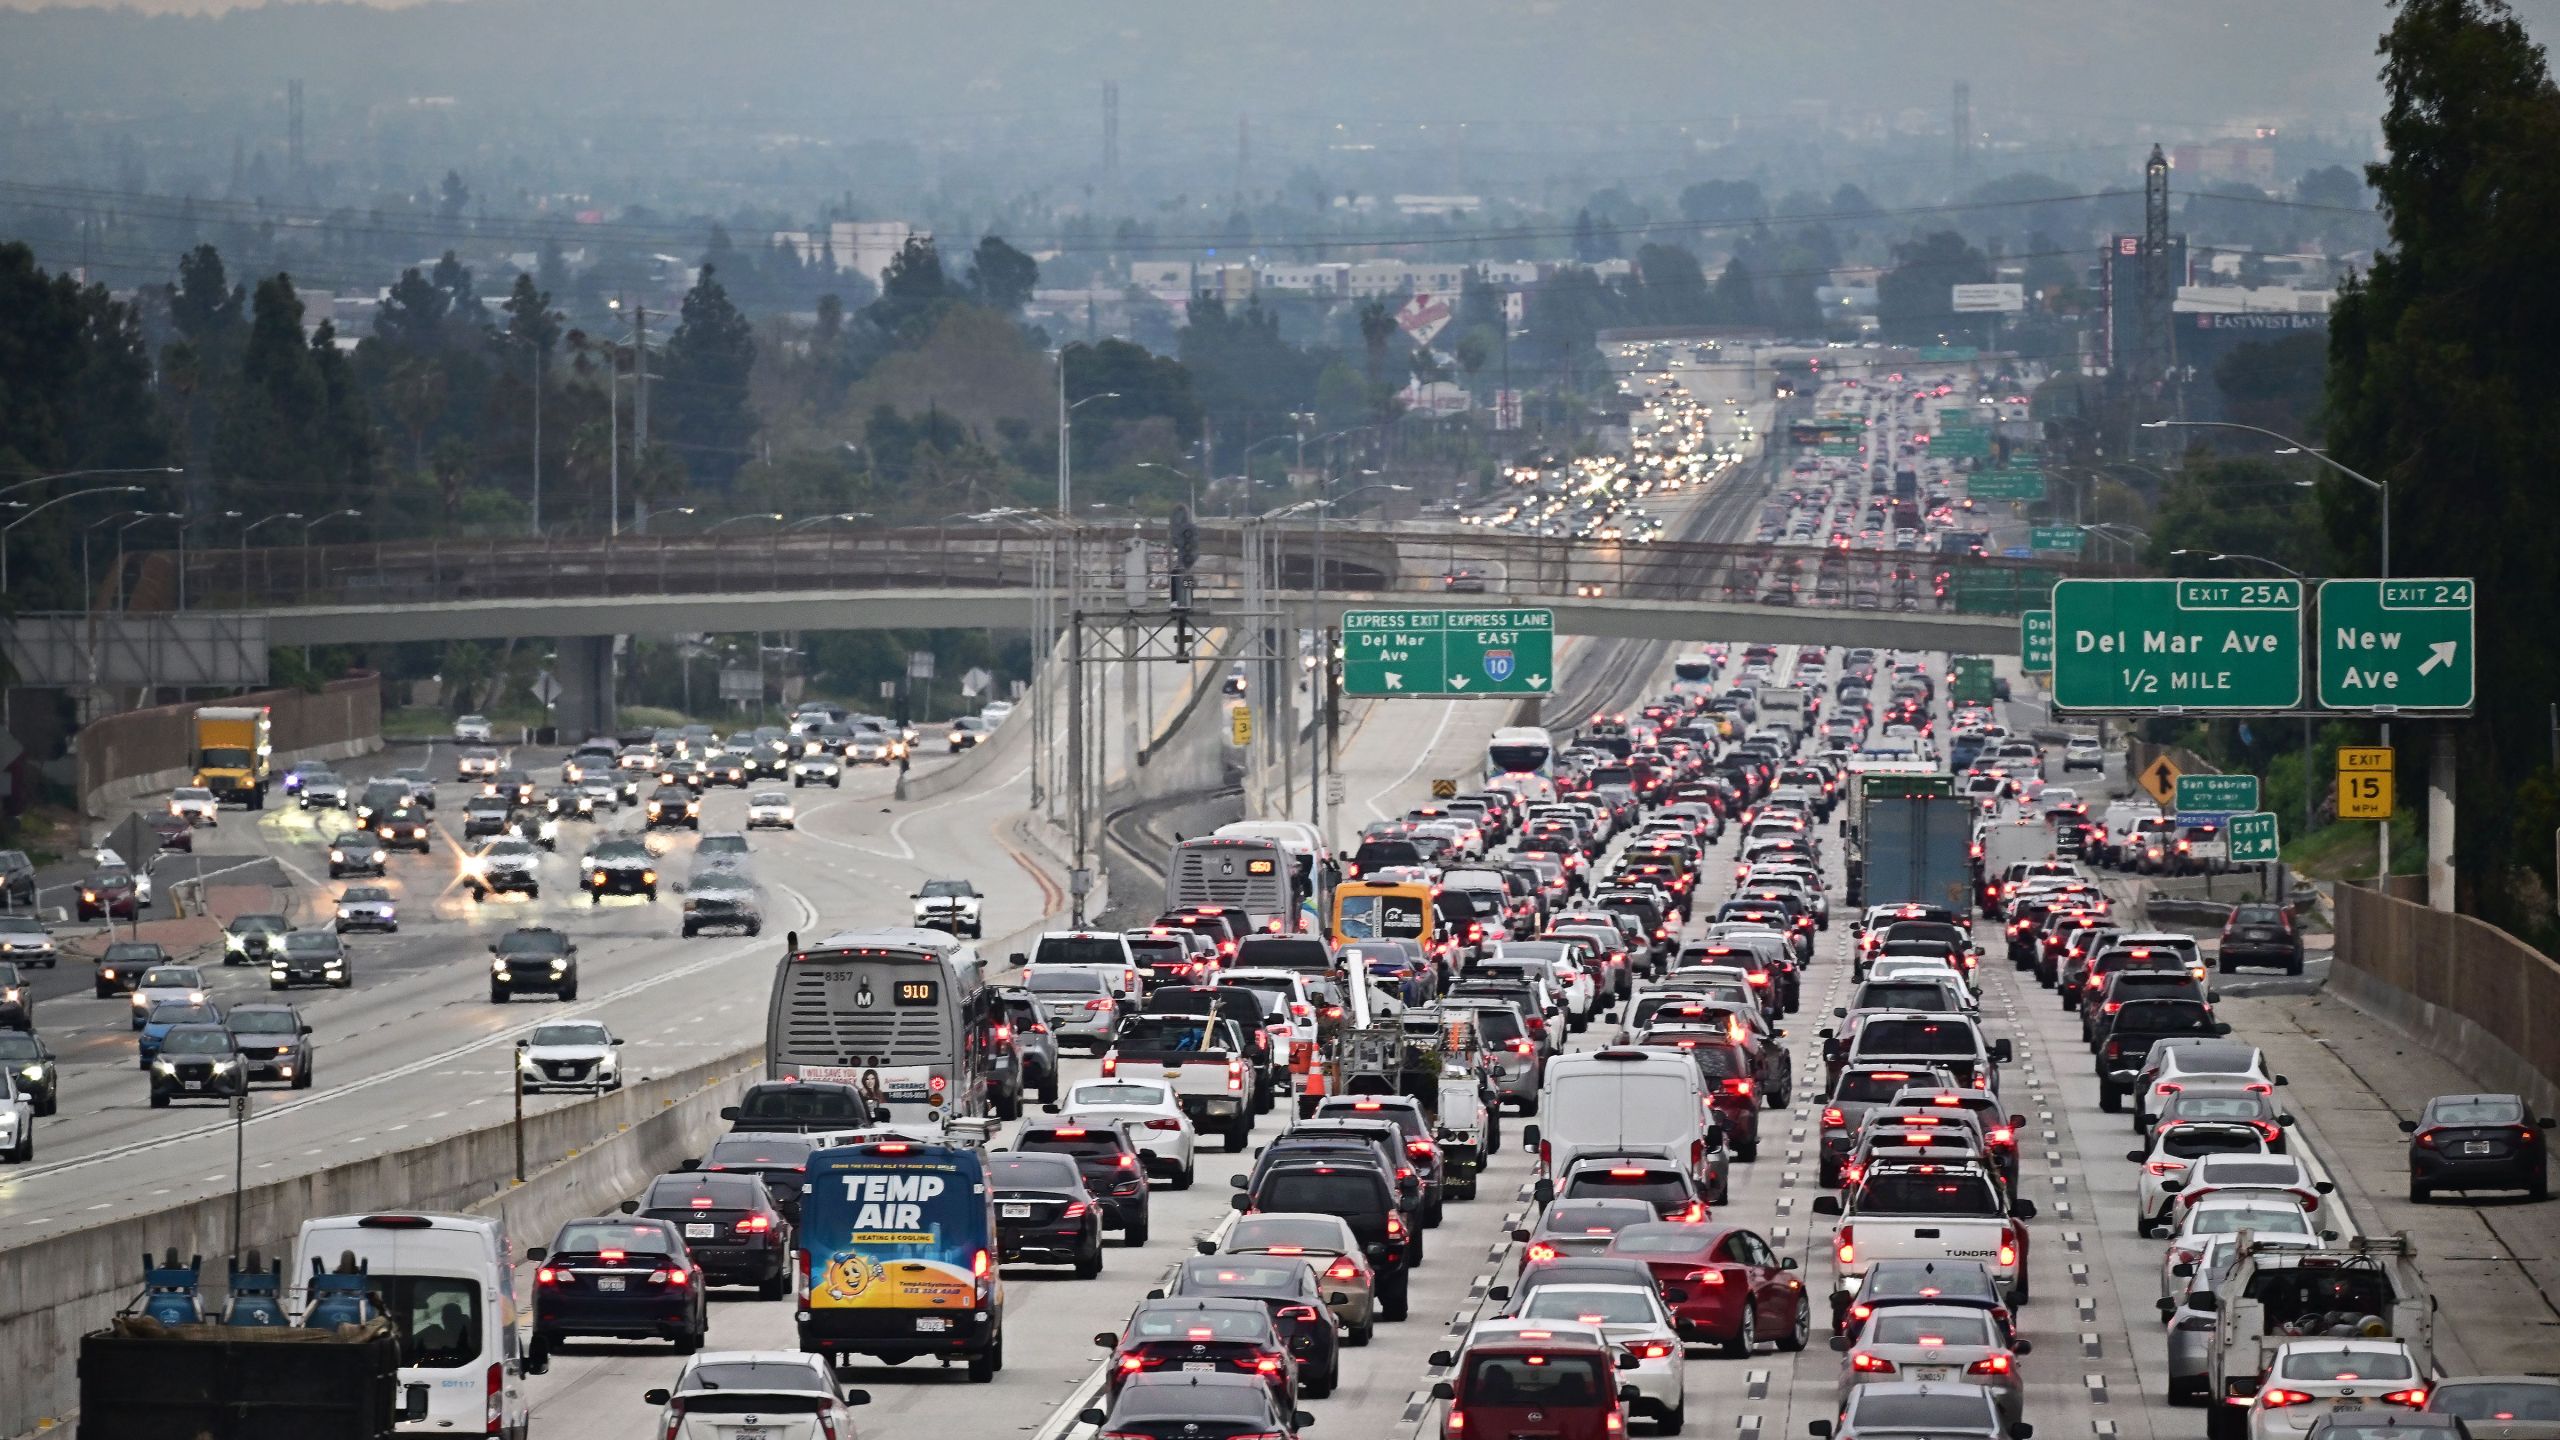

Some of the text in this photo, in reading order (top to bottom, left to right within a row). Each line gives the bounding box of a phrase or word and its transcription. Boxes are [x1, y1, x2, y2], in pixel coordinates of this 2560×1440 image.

[2188, 586, 2290, 603] EXIT 25A
[2387, 586, 2468, 602] EXIT 24
[1347, 615, 1440, 627] EXPRESS EXIT
[1449, 614, 1549, 626] EXPRESS LANE
[1361, 635, 1425, 646] Del Mar
[1477, 632, 1520, 644] EAST
[2075, 630, 2278, 653] Del Mar Ave
[2337, 628, 2402, 649] New
[1379, 650, 1409, 661] Ave
[1490, 661, 1507, 674] 10
[2171, 672, 2231, 689] MILE
[2341, 666, 2399, 688] Ave
[2349, 754, 2381, 765] EXIT
[2351, 778, 2380, 798] 15
[2352, 804, 2378, 812] MPH
[2233, 820, 2270, 834] EXIT
[2233, 841, 2252, 854] 24
[824, 971, 853, 981] 8357
[857, 991, 871, 1005] M
[903, 985, 929, 999] 910
[236, 1097, 245, 1111] 8
[842, 1175, 945, 1201] TEMP
[853, 1203, 921, 1229] AIR
